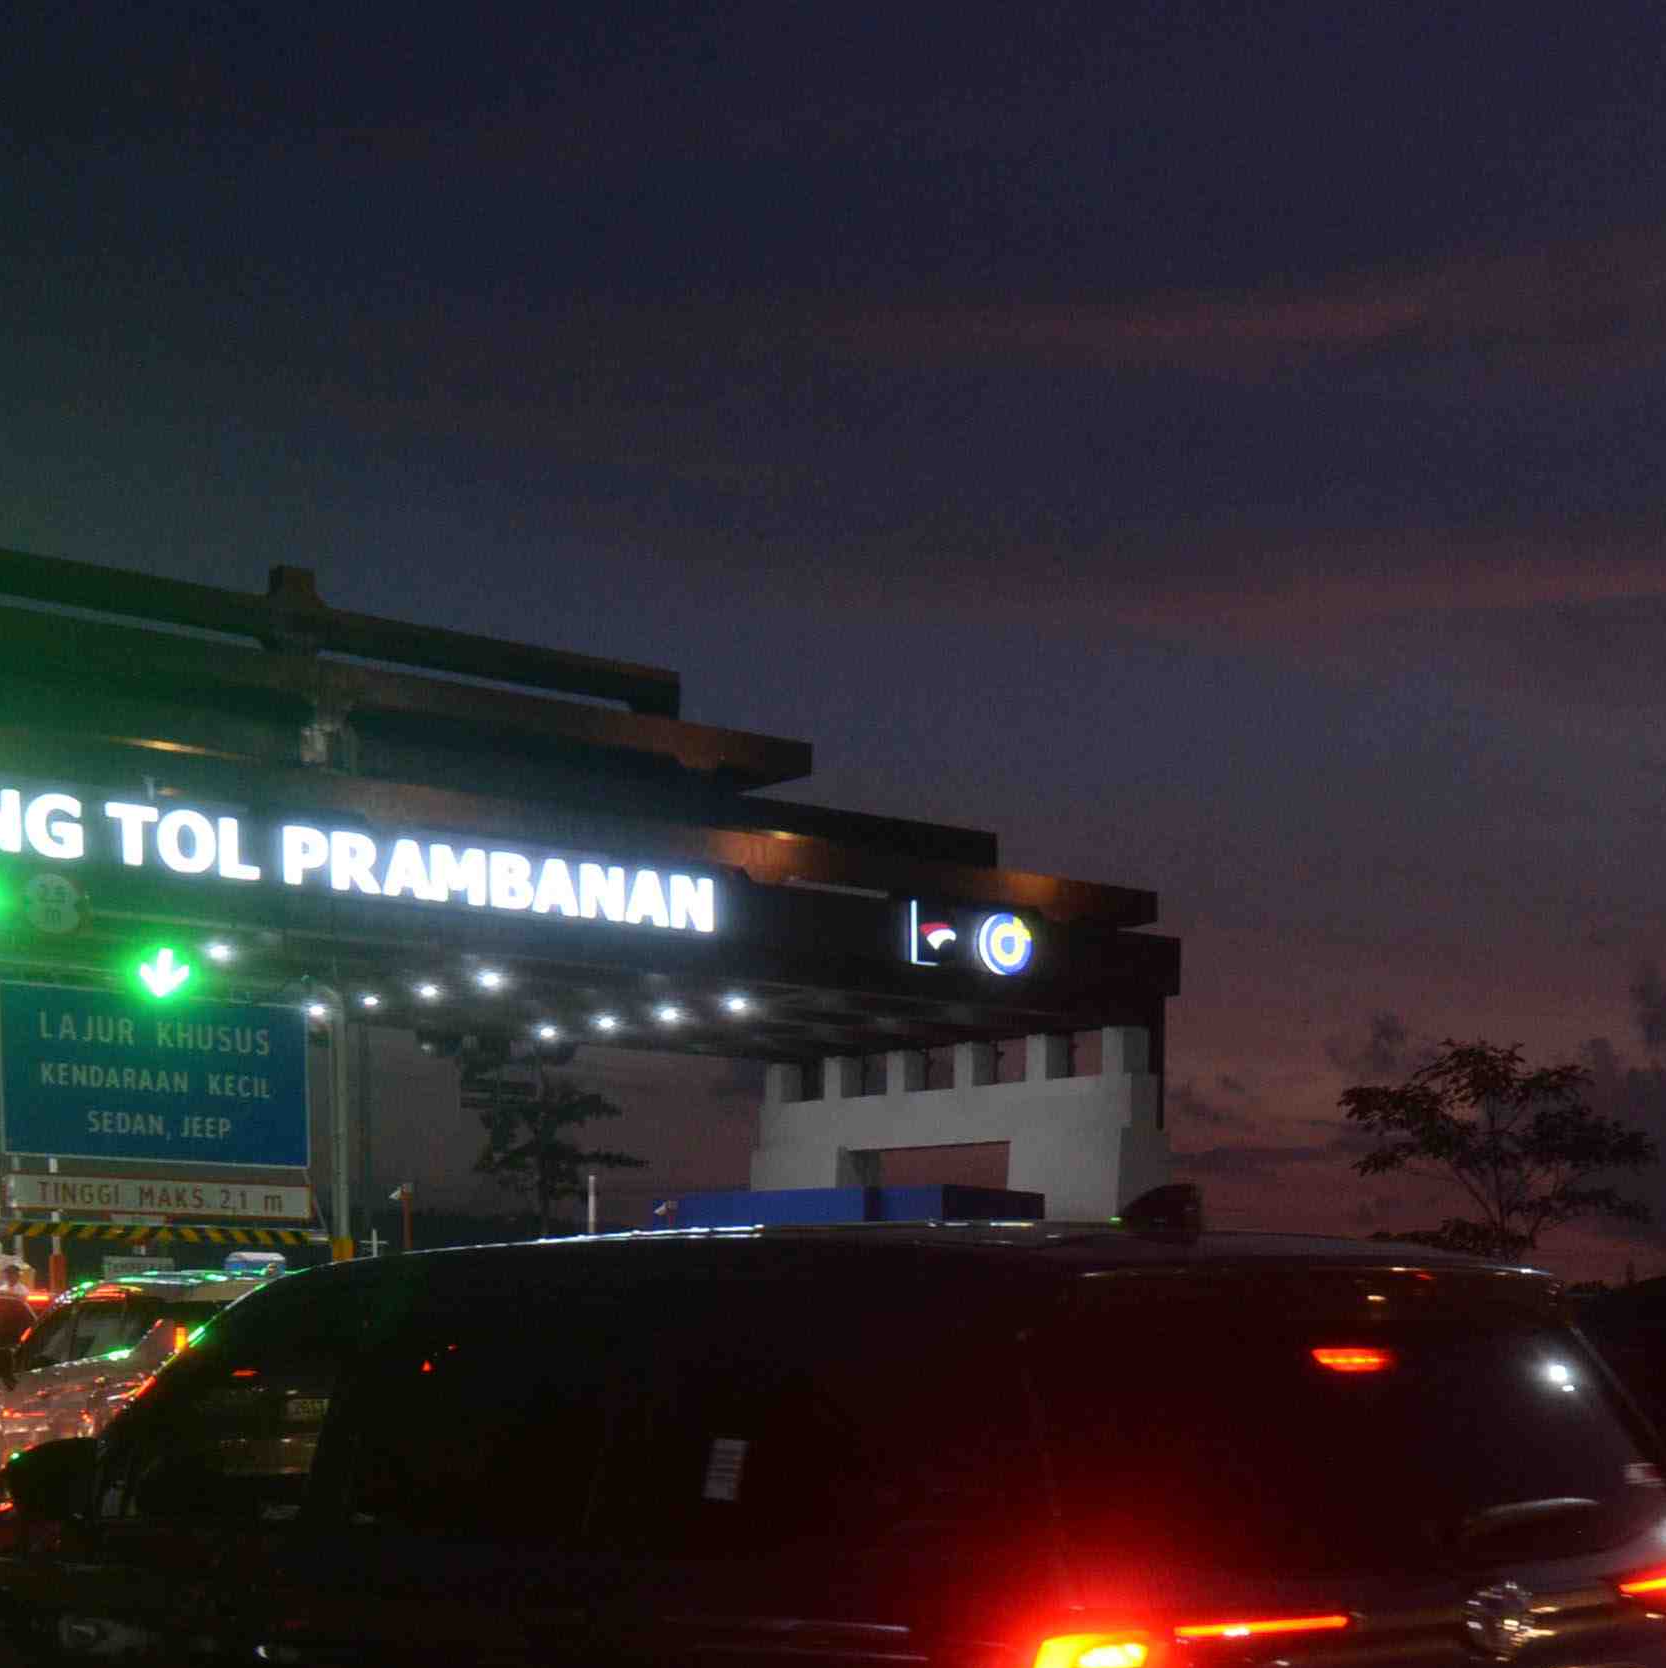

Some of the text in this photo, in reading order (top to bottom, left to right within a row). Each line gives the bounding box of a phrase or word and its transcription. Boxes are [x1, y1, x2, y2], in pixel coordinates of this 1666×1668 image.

[105, 801, 261, 882] TOL
[282, 825, 716, 933] PRAMBANAN
[39, 1011, 271, 1056] LAJUR KHUSUS
[40, 1063, 271, 1099] KENDARAAN KECIL
[87, 1110, 232, 1141] SEDAN, JEEP
[37, 1181, 120, 1205] TINGGI
[263, 1193, 284, 1213] m
